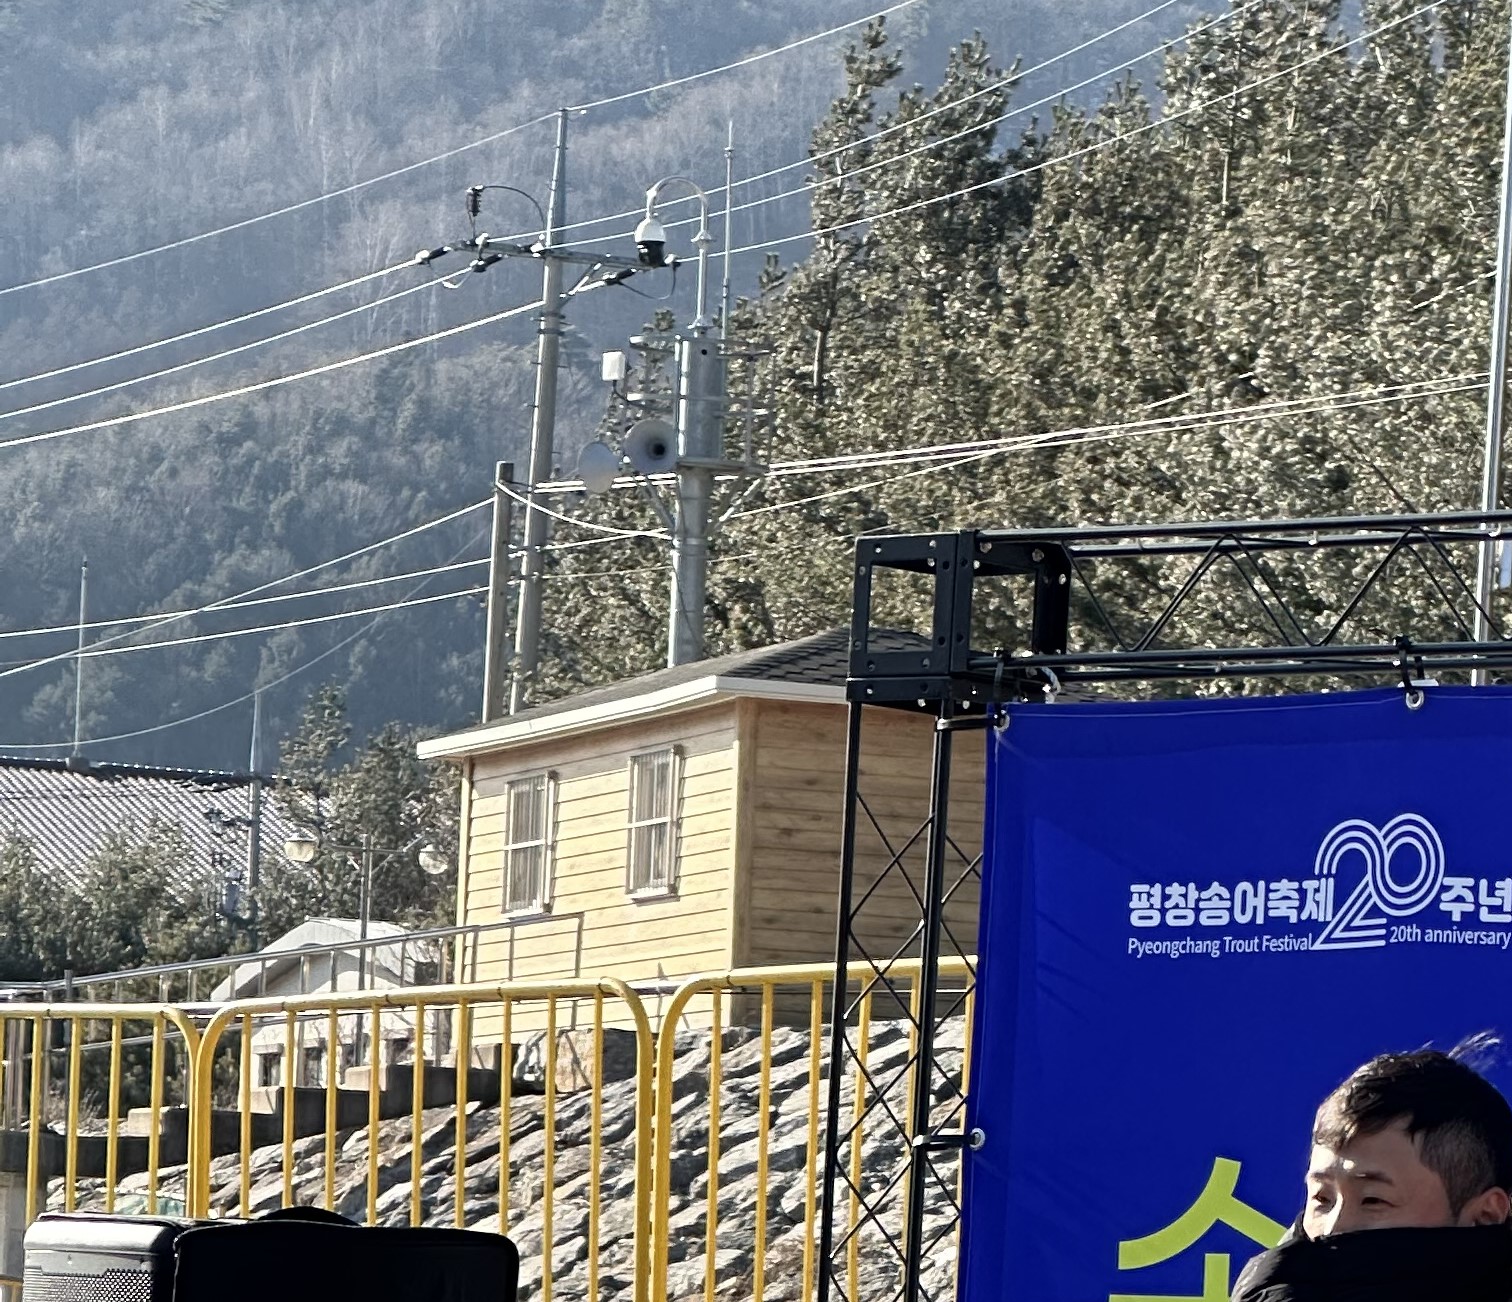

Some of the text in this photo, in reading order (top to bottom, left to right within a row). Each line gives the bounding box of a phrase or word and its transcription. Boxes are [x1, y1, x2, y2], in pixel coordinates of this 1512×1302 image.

[1128, 876, 1335, 928] 평창송어축제
[1127, 925, 1512, 959] Pyeongchang Trout Festival 20th anniversary
